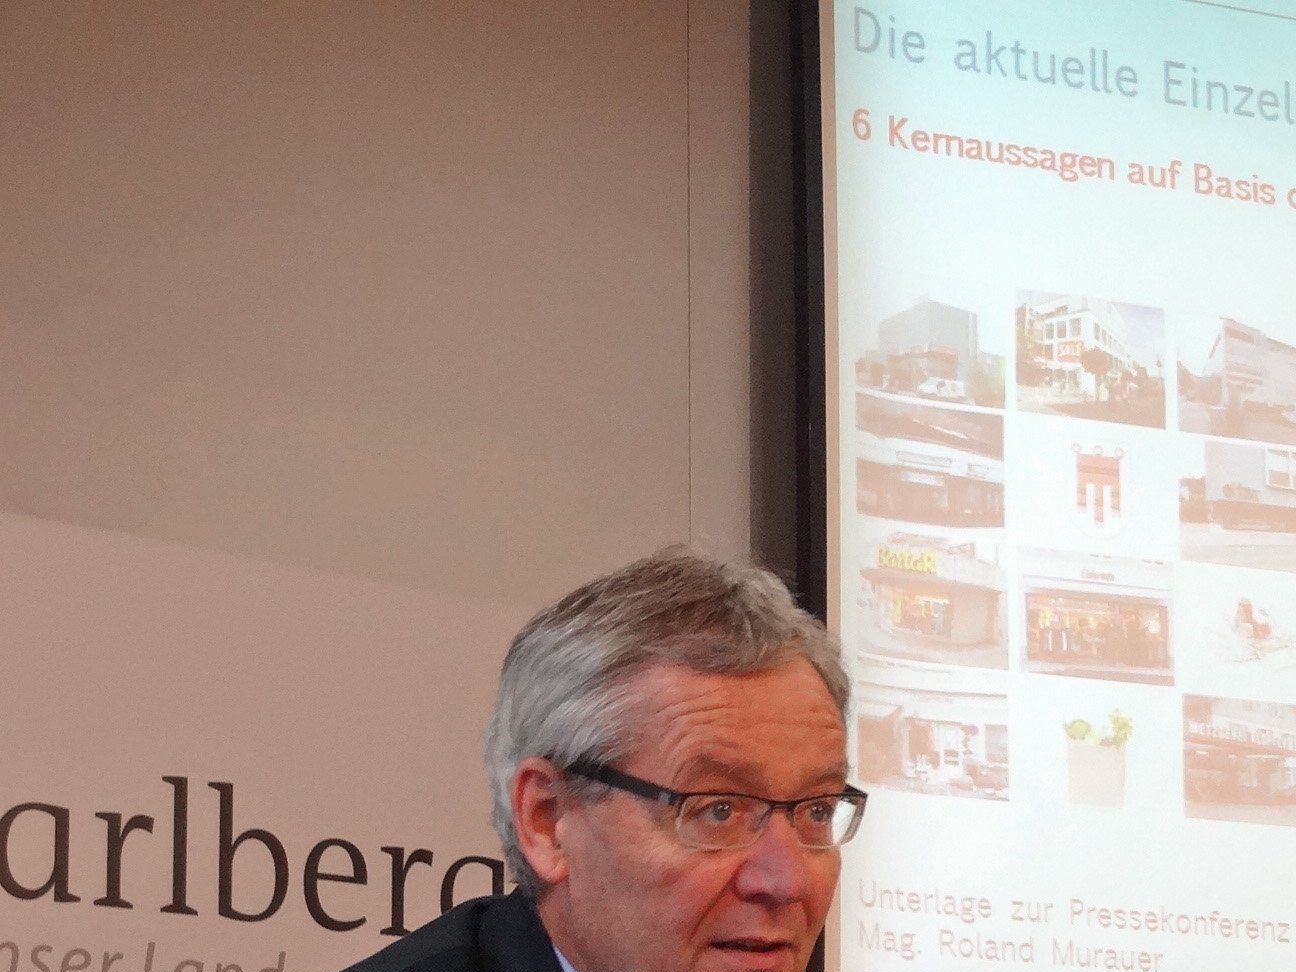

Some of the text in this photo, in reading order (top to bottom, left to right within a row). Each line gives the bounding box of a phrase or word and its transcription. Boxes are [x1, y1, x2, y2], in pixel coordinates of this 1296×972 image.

[852, 6, 927, 63] Die
[954, 31, 1139, 98] aktuelle
[851, 108, 873, 141] 6
[888, 115, 1116, 183] Kernaussagen
[1127, 158, 1182, 191] auf
[1193, 164, 1276, 206] Basis
[857, 879, 994, 922] Unterlage
[1011, 898, 1054, 924] zur
[1069, 898, 1291, 945] Pressekonferenz
[857, 920, 922, 961] Mag.
[939, 929, 1035, 964] Roland
